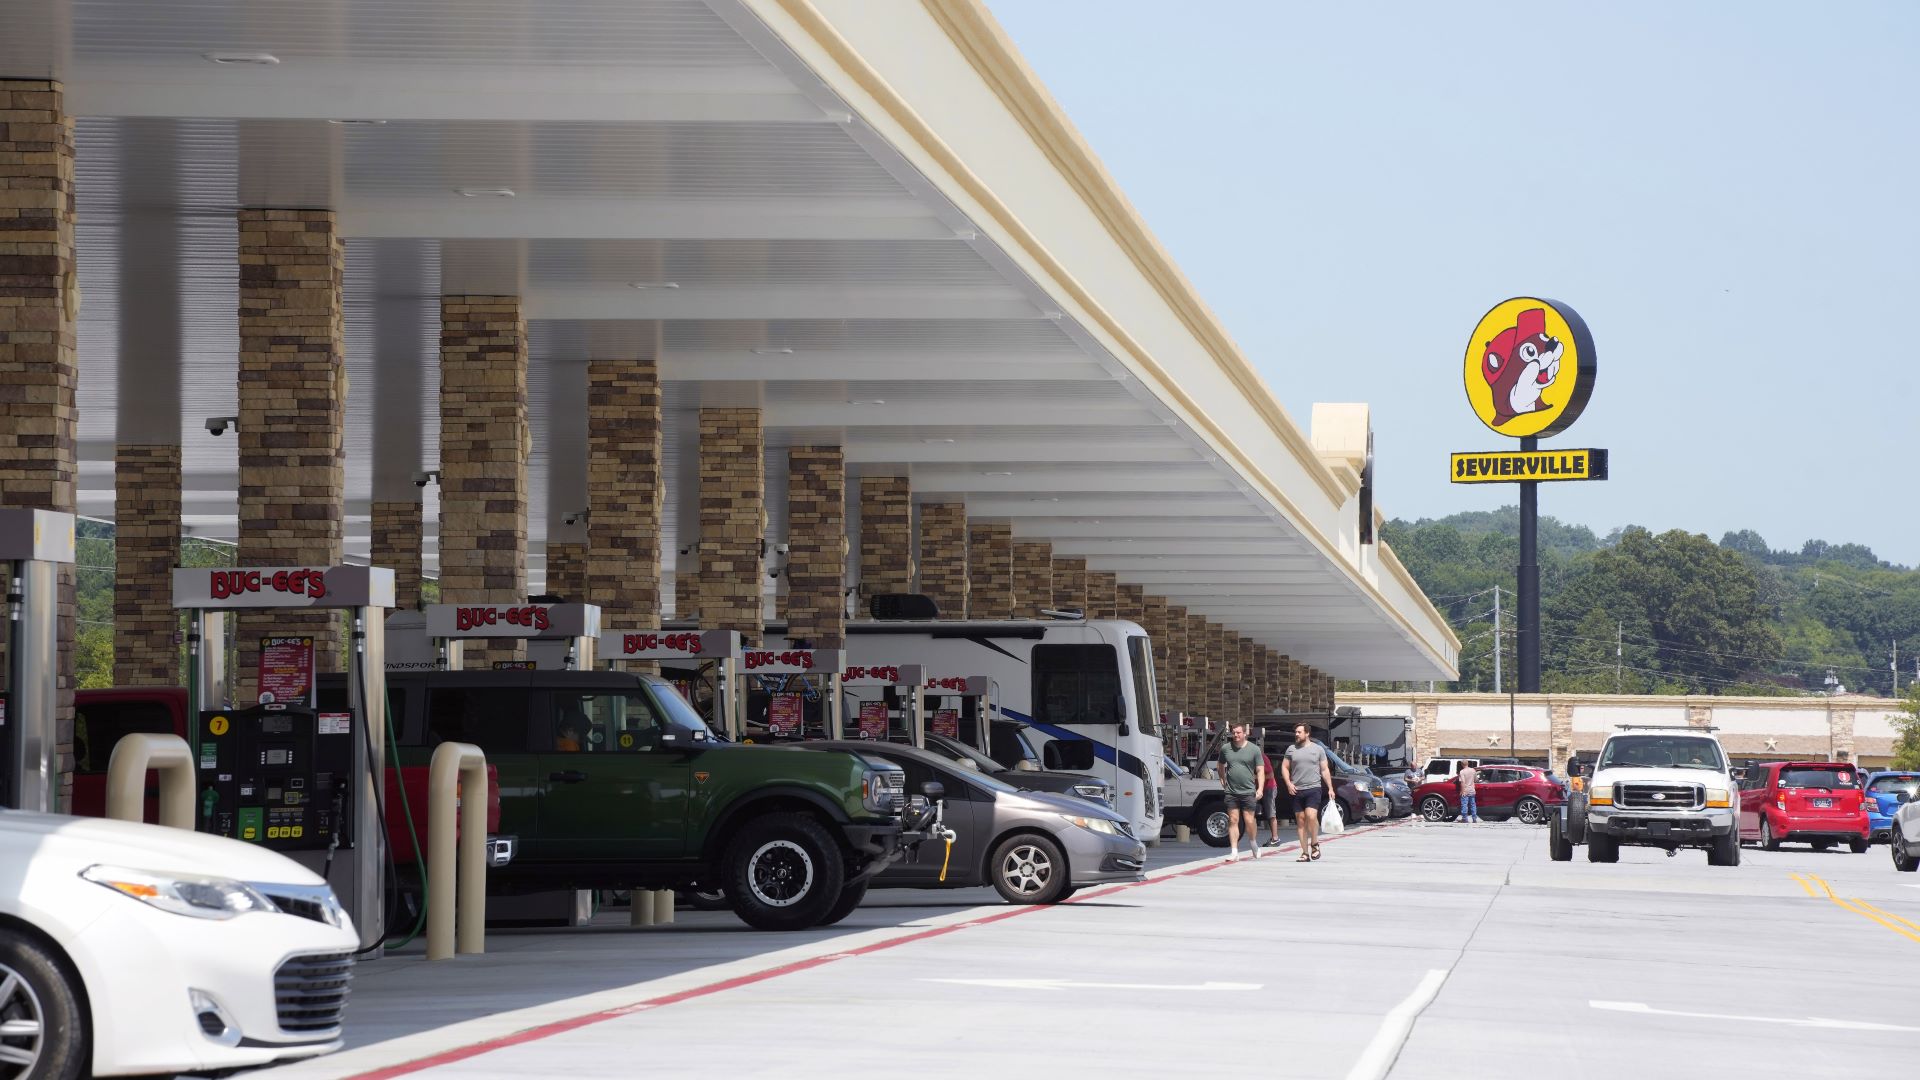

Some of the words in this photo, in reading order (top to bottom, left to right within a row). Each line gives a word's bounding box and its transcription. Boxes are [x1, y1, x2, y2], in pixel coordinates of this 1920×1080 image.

[1456, 455, 1585, 478] SEVIERVILLE
[210, 568, 326, 600] BUC-EE'S
[456, 605, 549, 631] BUC-EE'S
[623, 632, 702, 654] BUC-EE'S
[745, 650, 813, 669] BUC-EE'S
[216, 720, 222, 731] 7
